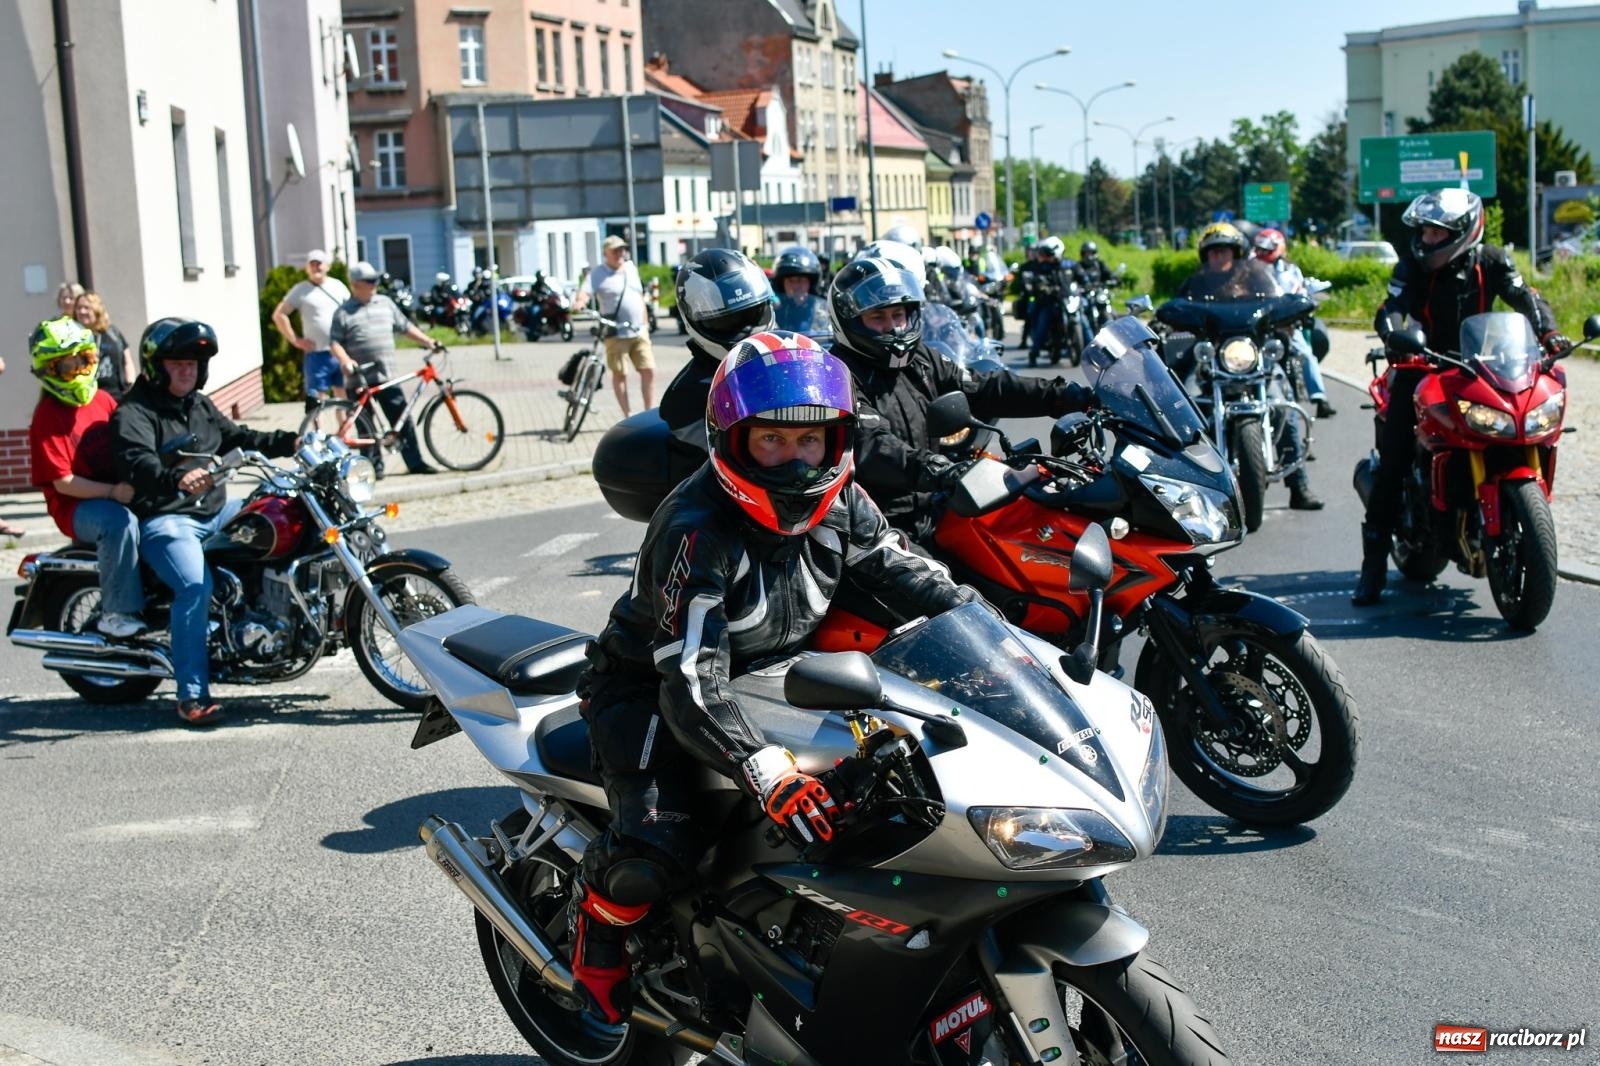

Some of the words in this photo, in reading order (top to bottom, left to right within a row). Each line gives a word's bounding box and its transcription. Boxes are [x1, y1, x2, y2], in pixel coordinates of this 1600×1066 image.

[795, 884, 857, 912] YZF
[847, 910, 911, 934] R1
[936, 996, 987, 1040] MOTUL
